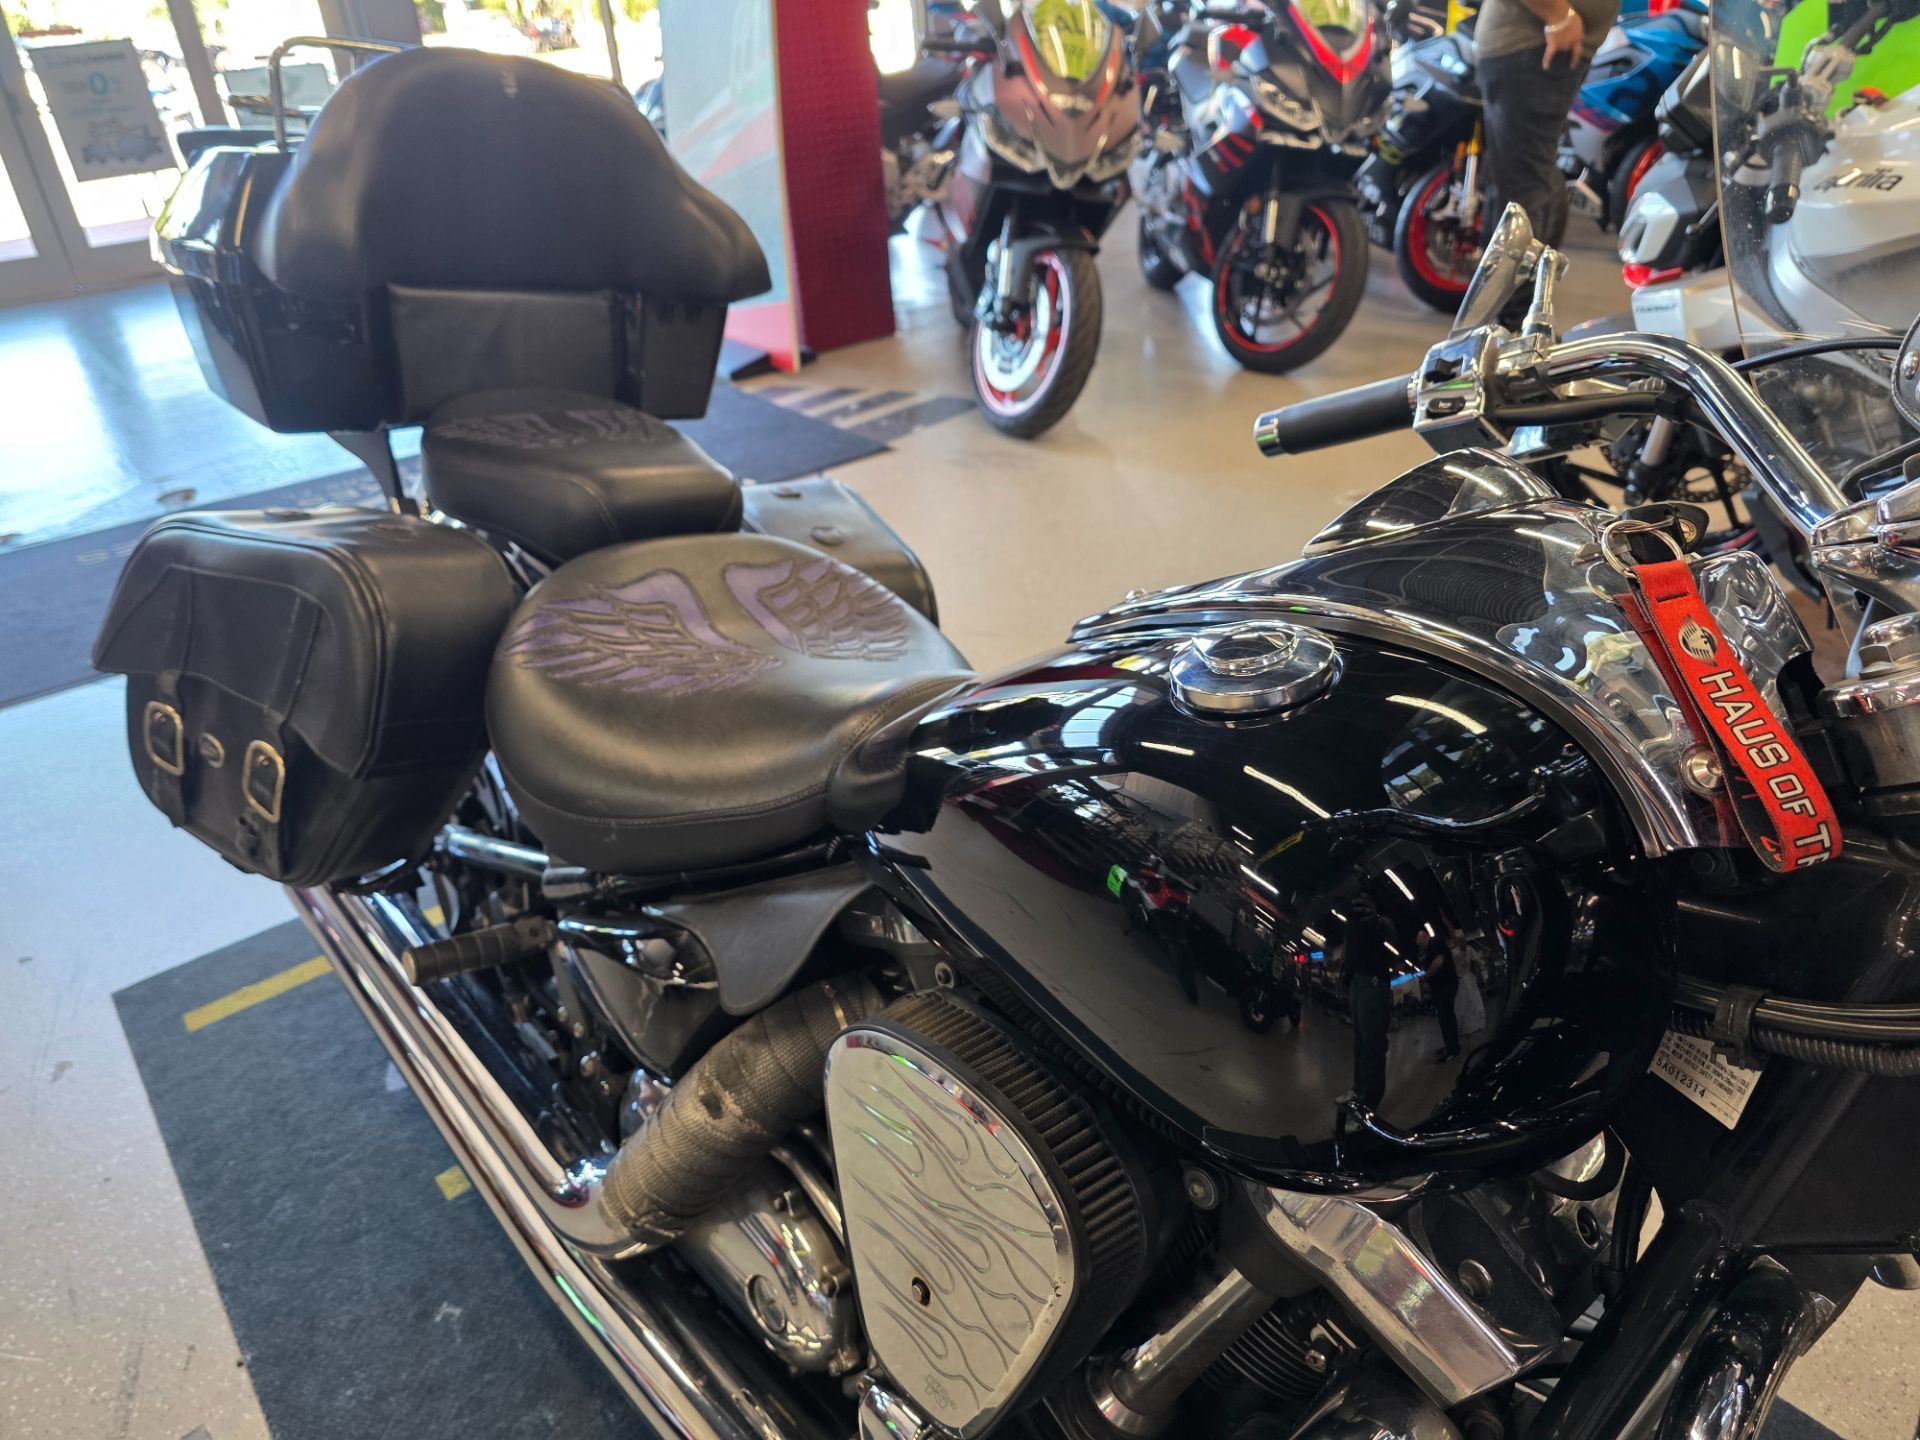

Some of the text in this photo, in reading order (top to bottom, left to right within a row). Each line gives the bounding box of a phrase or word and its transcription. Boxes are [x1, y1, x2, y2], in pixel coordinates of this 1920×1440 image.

[1699, 669, 1792, 769] HAUS
[1767, 772, 1817, 818] OF
[1656, 1057, 1706, 1098] 5A012314
